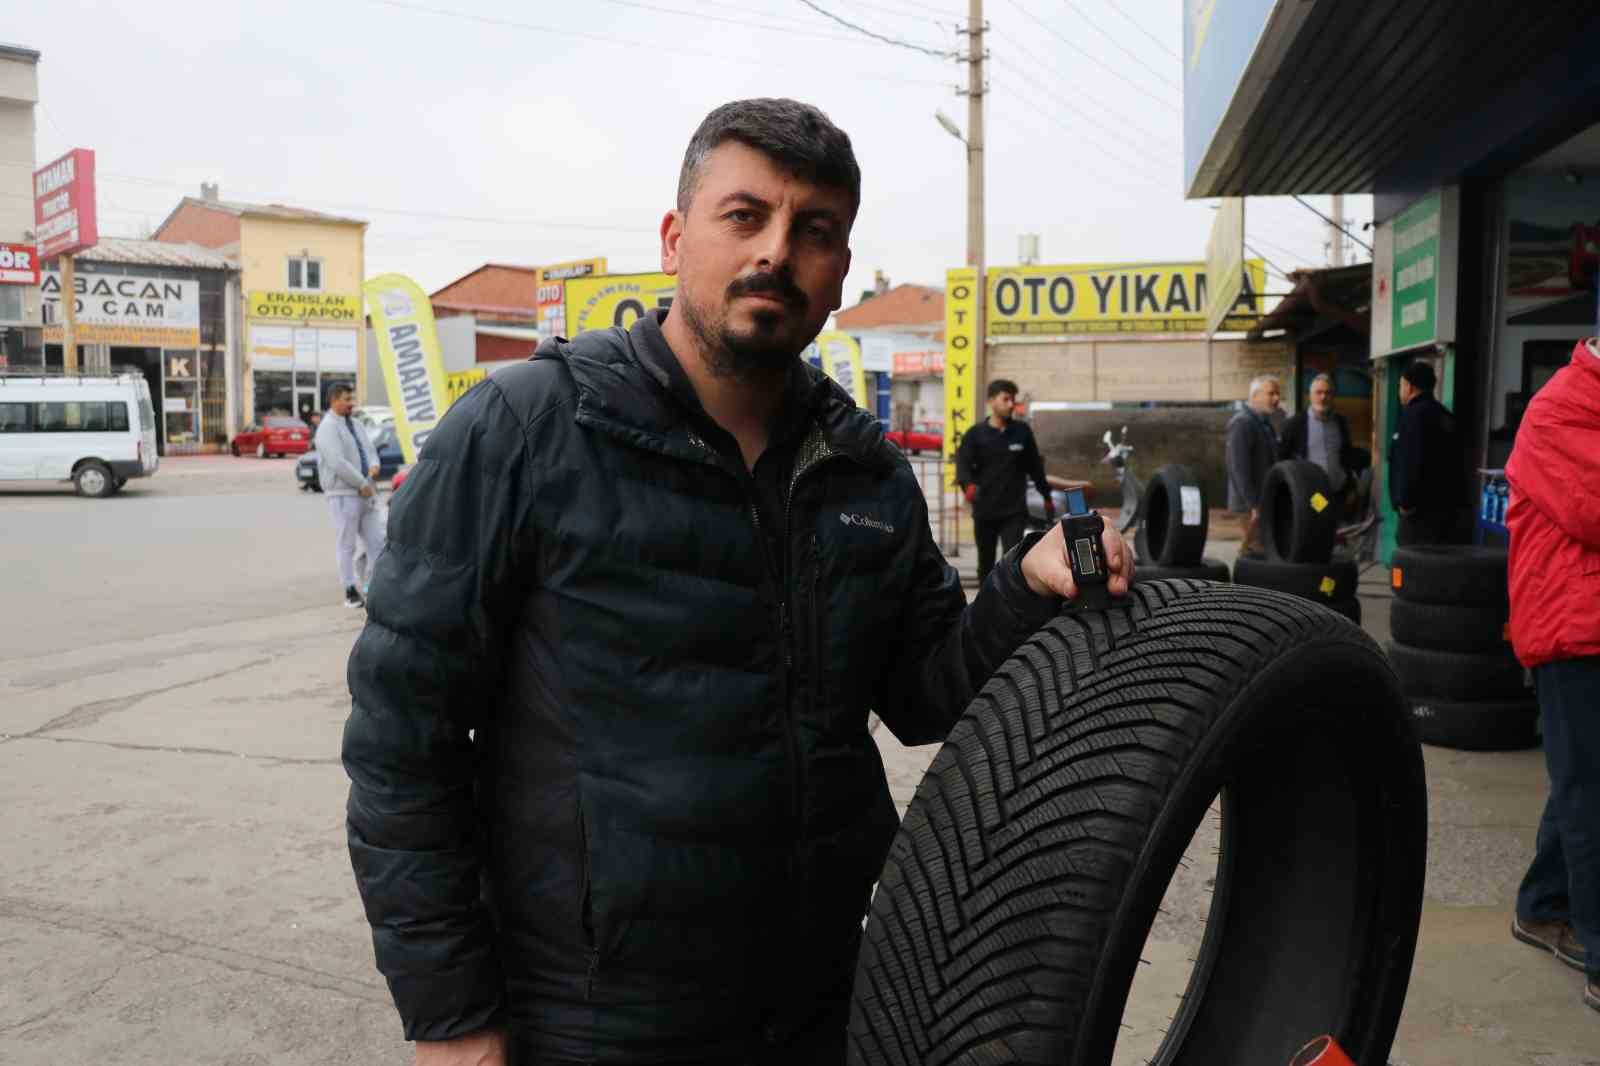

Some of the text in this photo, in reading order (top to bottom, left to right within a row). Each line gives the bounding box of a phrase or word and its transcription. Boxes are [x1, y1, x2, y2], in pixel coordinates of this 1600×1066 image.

[995, 277, 1076, 316] OTO
[103, 301, 164, 317] CAM
[257, 304, 355, 319] OTO JAPON
[171, 358, 190, 377] K
